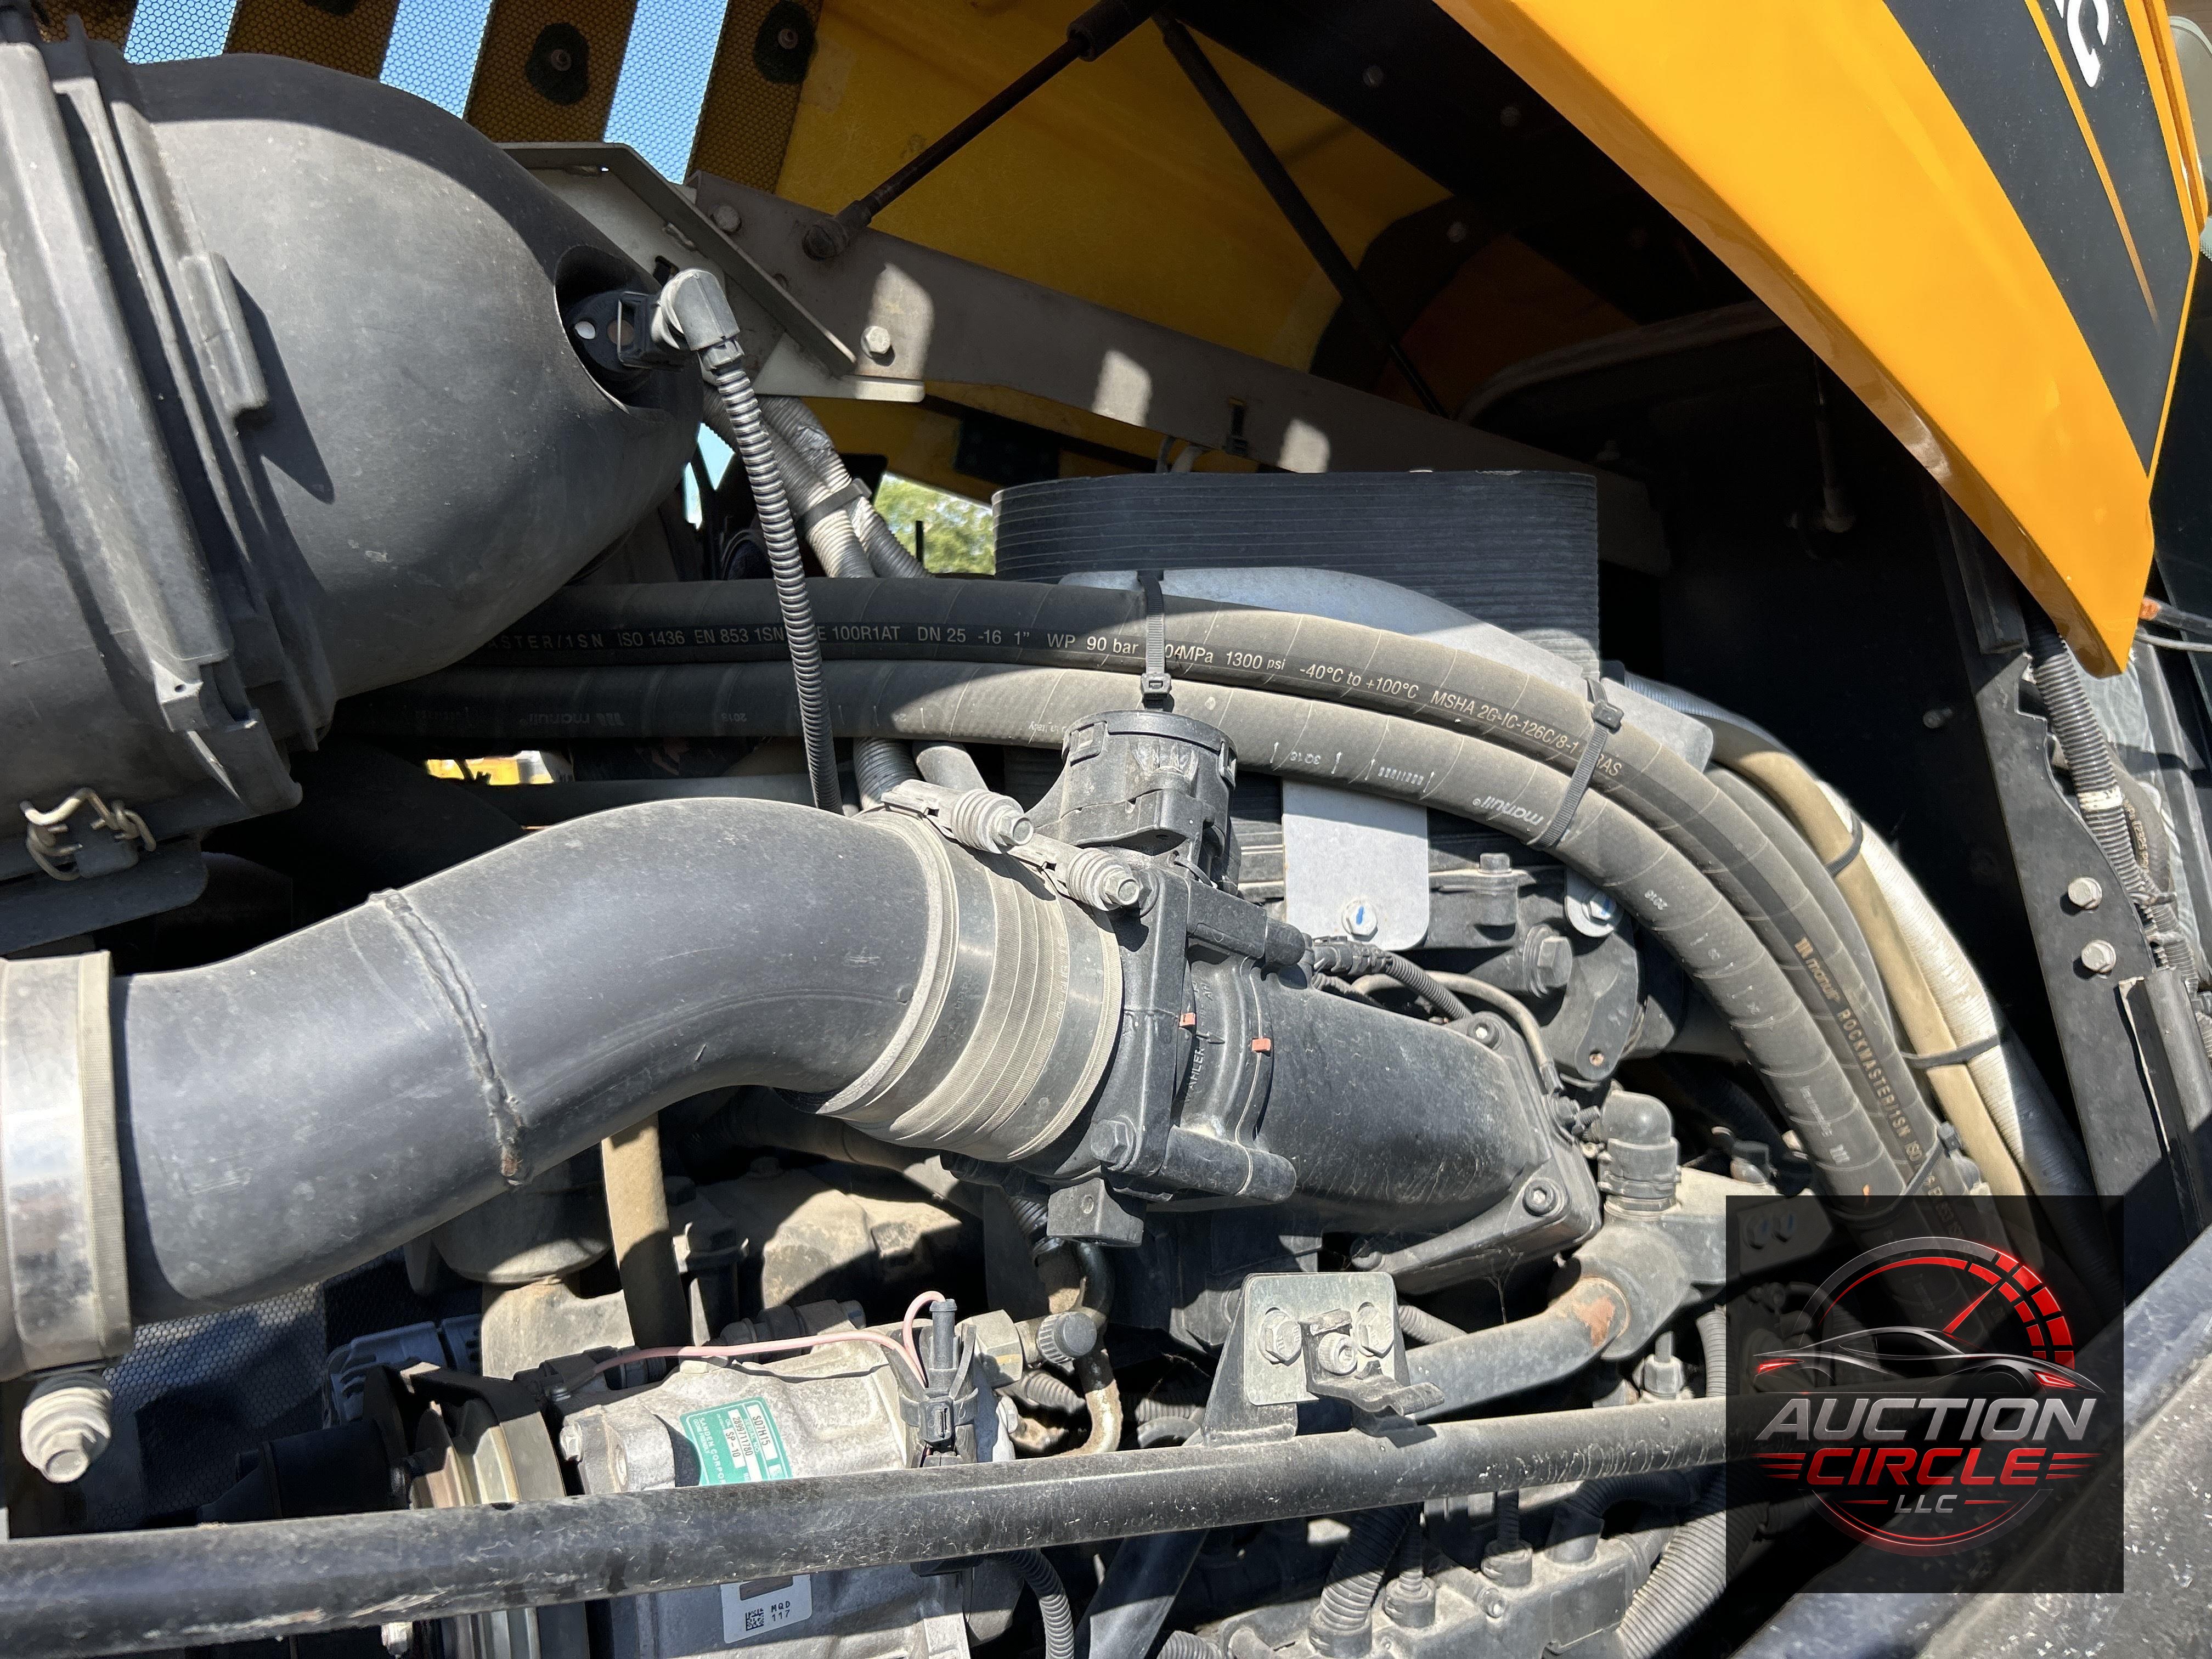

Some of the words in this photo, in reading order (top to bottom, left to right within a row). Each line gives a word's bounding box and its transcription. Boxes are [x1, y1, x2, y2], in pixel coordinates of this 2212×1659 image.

[618, 631, 644, 647] ISO
[648, 629, 685, 646] 1436
[695, 629, 715, 645] EN
[720, 628, 749, 644] 853
[754, 626, 784, 642] 1SN
[832, 625, 900, 641] 100R1AT
[917, 627, 940, 642] DN
[947, 628, 967, 643] 25
[978, 629, 1002, 645] -16
[1047, 633, 1076, 649] WP
[1086, 636, 1107, 652] 90
[1113, 637, 1139, 655] bar
[1226, 651, 1263, 670] 1300
[1266, 658, 1286, 671] psi
[1299, 663, 1344, 682] -40°C
[1346, 671, 1362, 686] to
[1365, 678, 1420, 700] +100°C
[1430, 690, 1475, 716] MSHA
[698, 1417, 715, 1448] SANDEN
[732, 1416, 754, 1457] 2899711780
[752, 1415, 771, 1446] SD7H15
[771, 1600, 791, 1613] MQD
[771, 1609, 791, 1622] 117
